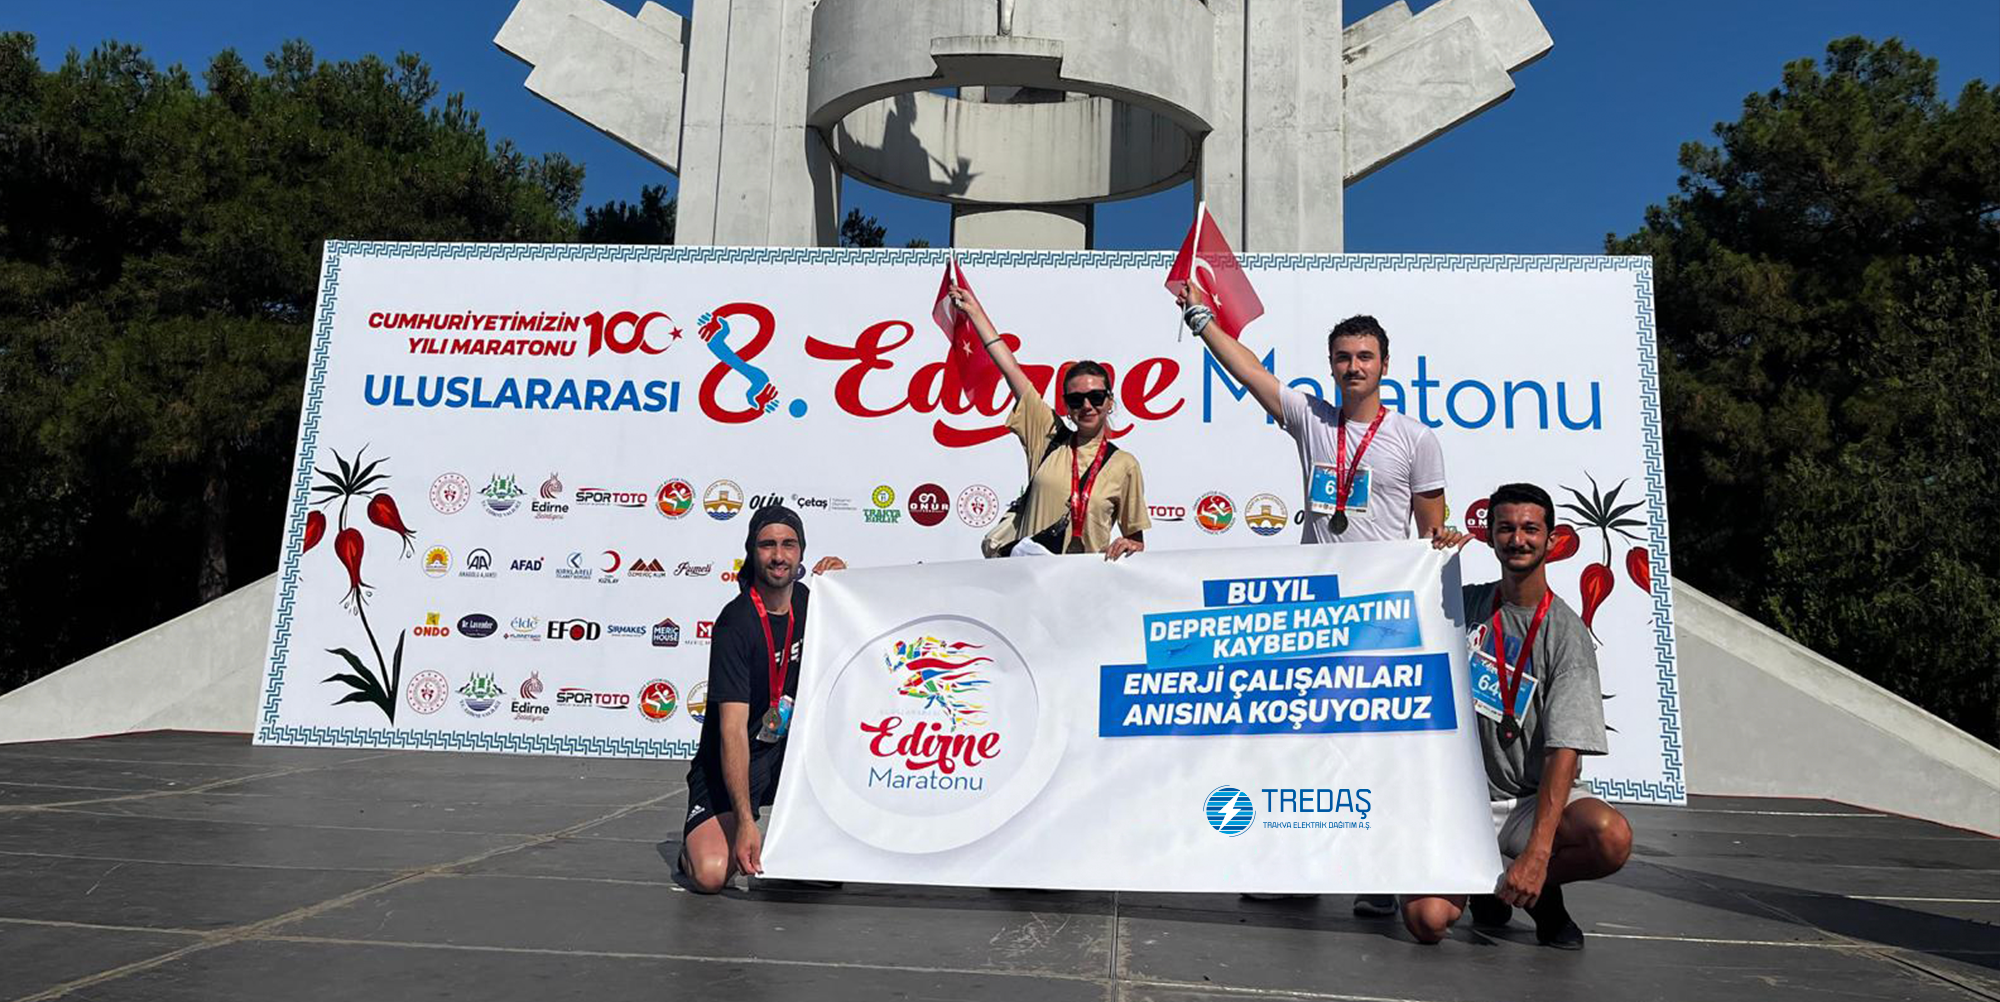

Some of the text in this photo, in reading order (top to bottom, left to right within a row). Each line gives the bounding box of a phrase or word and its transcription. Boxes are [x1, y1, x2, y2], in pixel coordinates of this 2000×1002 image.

[368, 310, 580, 333] CUMHURİYETİMİZİN
[408, 337, 577, 357] YILI MARATONU
[364, 374, 680, 413] ULUSLARARASI
[531, 501, 569, 513] Edirne
[797, 497, 828, 509] Çetaş
[910, 503, 949, 511] ONUR
[510, 559, 542, 571] AFAD
[1227, 579, 1315, 605] BU YIL
[413, 626, 450, 637] ONDO
[1150, 598, 1411, 642] DEPREMDE HAYATINI
[653, 634, 678, 642] HOUSE
[1213, 627, 1350, 658] KAYBEDEN
[1123, 664, 1423, 699] ENERJİ ÇALIŞANLARI
[1478, 674, 1505, 700] 64
[511, 702, 550, 715] Edirne
[1122, 696, 1432, 730] ANISINA KOŞUYORUZ
[860, 716, 1001, 774] Edirne
[868, 767, 983, 791] Maratonu
[1261, 788, 1372, 820] TREDAŞ
[1263, 821, 1292, 829] TRAKYA
[1293, 820, 1327, 829] ELEKTRİK
[1328, 820, 1357, 829] DAĞITIM
